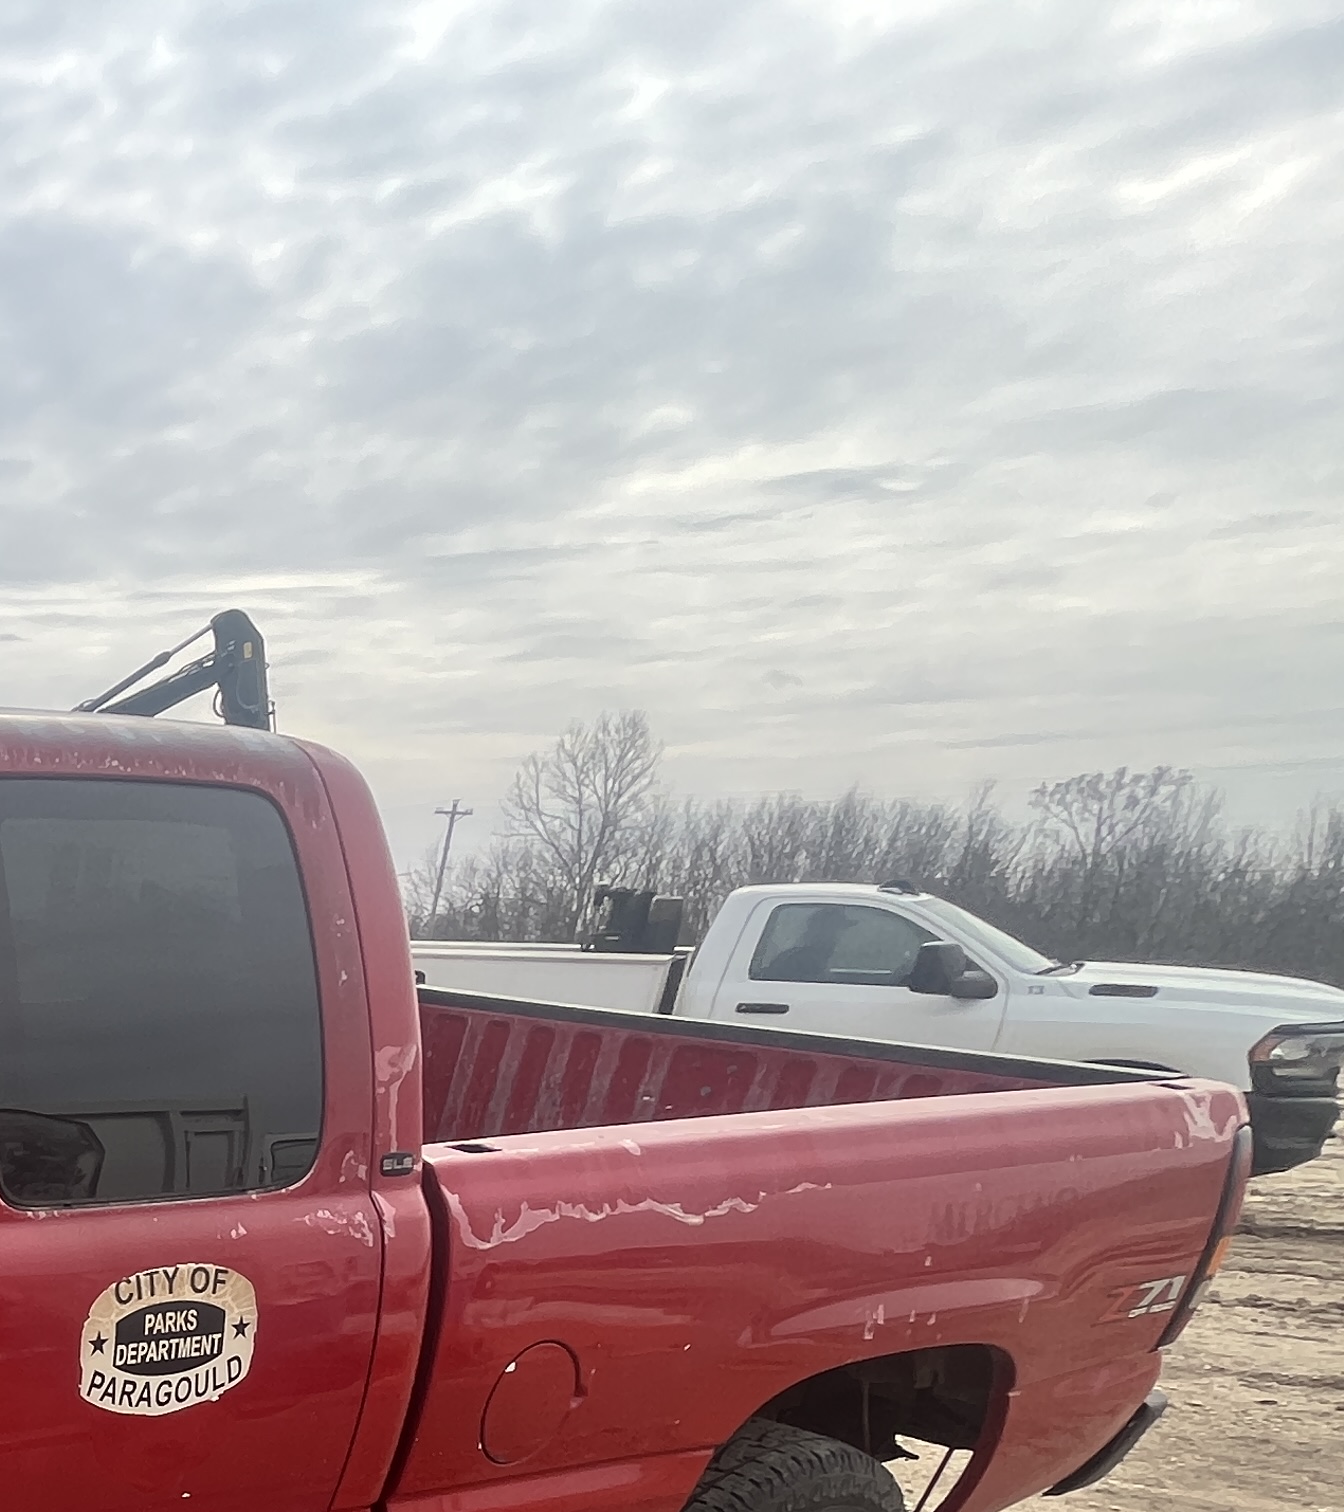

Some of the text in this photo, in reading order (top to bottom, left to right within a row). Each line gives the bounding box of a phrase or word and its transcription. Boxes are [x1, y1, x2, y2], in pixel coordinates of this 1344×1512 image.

[114, 1266, 229, 1305] CITY OF
[144, 1309, 198, 1336] PARKS
[115, 1333, 223, 1367] DEPARTMENT
[86, 1355, 243, 1408] PARAGOULD
